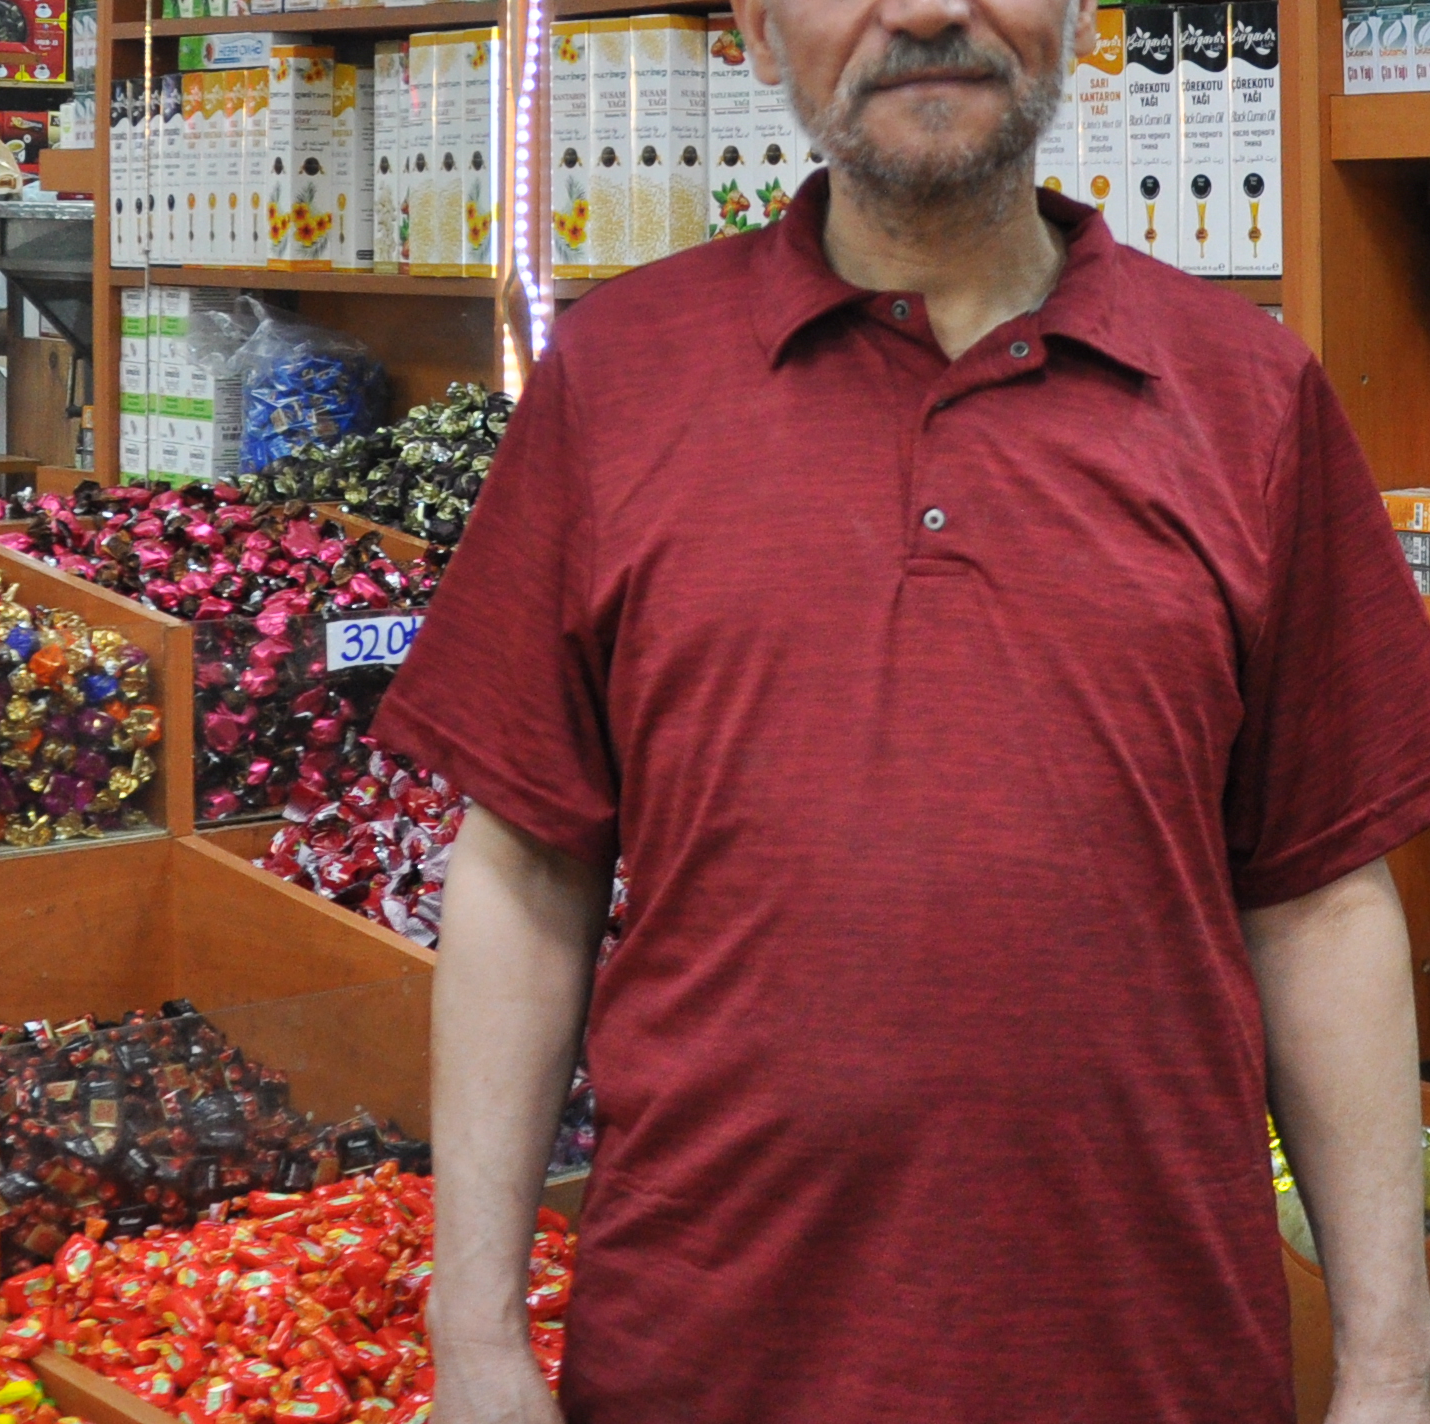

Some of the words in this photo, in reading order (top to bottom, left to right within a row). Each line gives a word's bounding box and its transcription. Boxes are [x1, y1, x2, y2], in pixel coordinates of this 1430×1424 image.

[1090, 78, 1109, 89] SARI
[1129, 80, 1170, 94] ÇÖREKOTU
[1181, 79, 1223, 93] ÇÖREKOTU
[1231, 77, 1275, 91] ÇÖREKOTU
[639, 88, 668, 98] SUSAM
[1079, 90, 1121, 102] KANTARON
[1191, 92, 1210, 106] YAĞI
[1243, 90, 1262, 104] YAĞI
[1140, 94, 1158, 107] YAĞI
